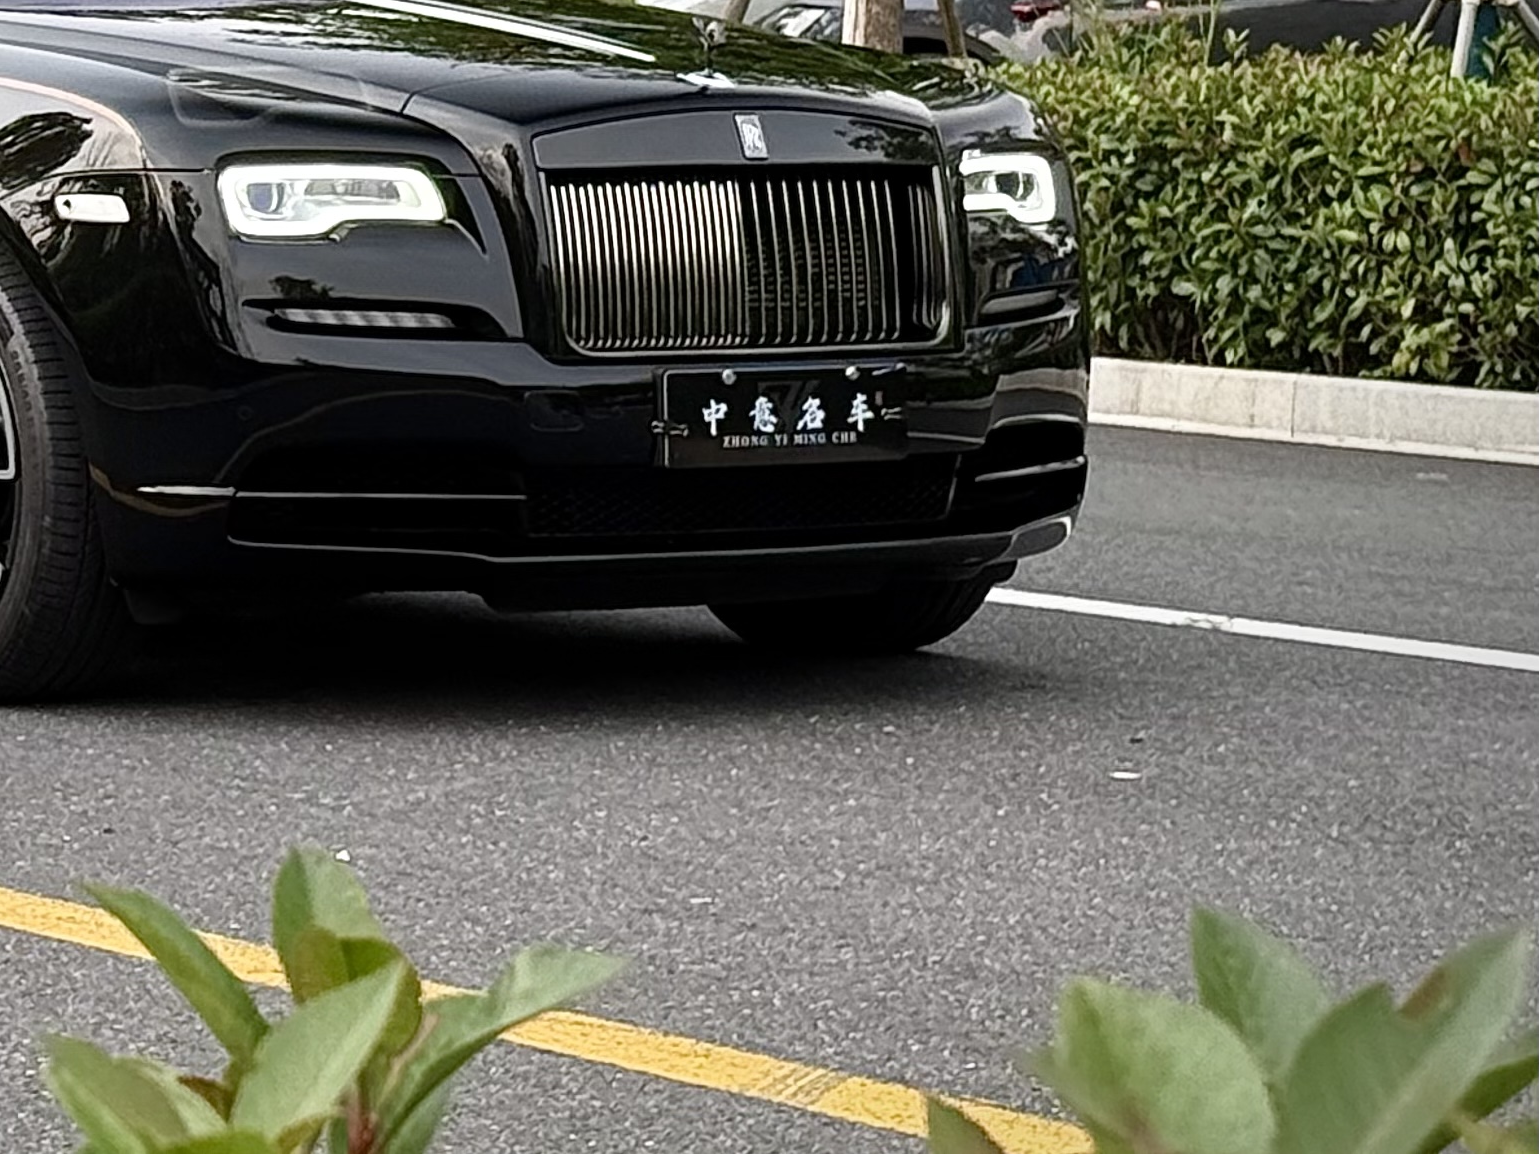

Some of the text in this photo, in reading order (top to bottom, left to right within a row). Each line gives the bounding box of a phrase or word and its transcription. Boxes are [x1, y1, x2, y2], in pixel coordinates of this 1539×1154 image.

[722, 434, 768, 448] ZHONG
[774, 433, 788, 446] YI
[793, 432, 827, 446] MING
